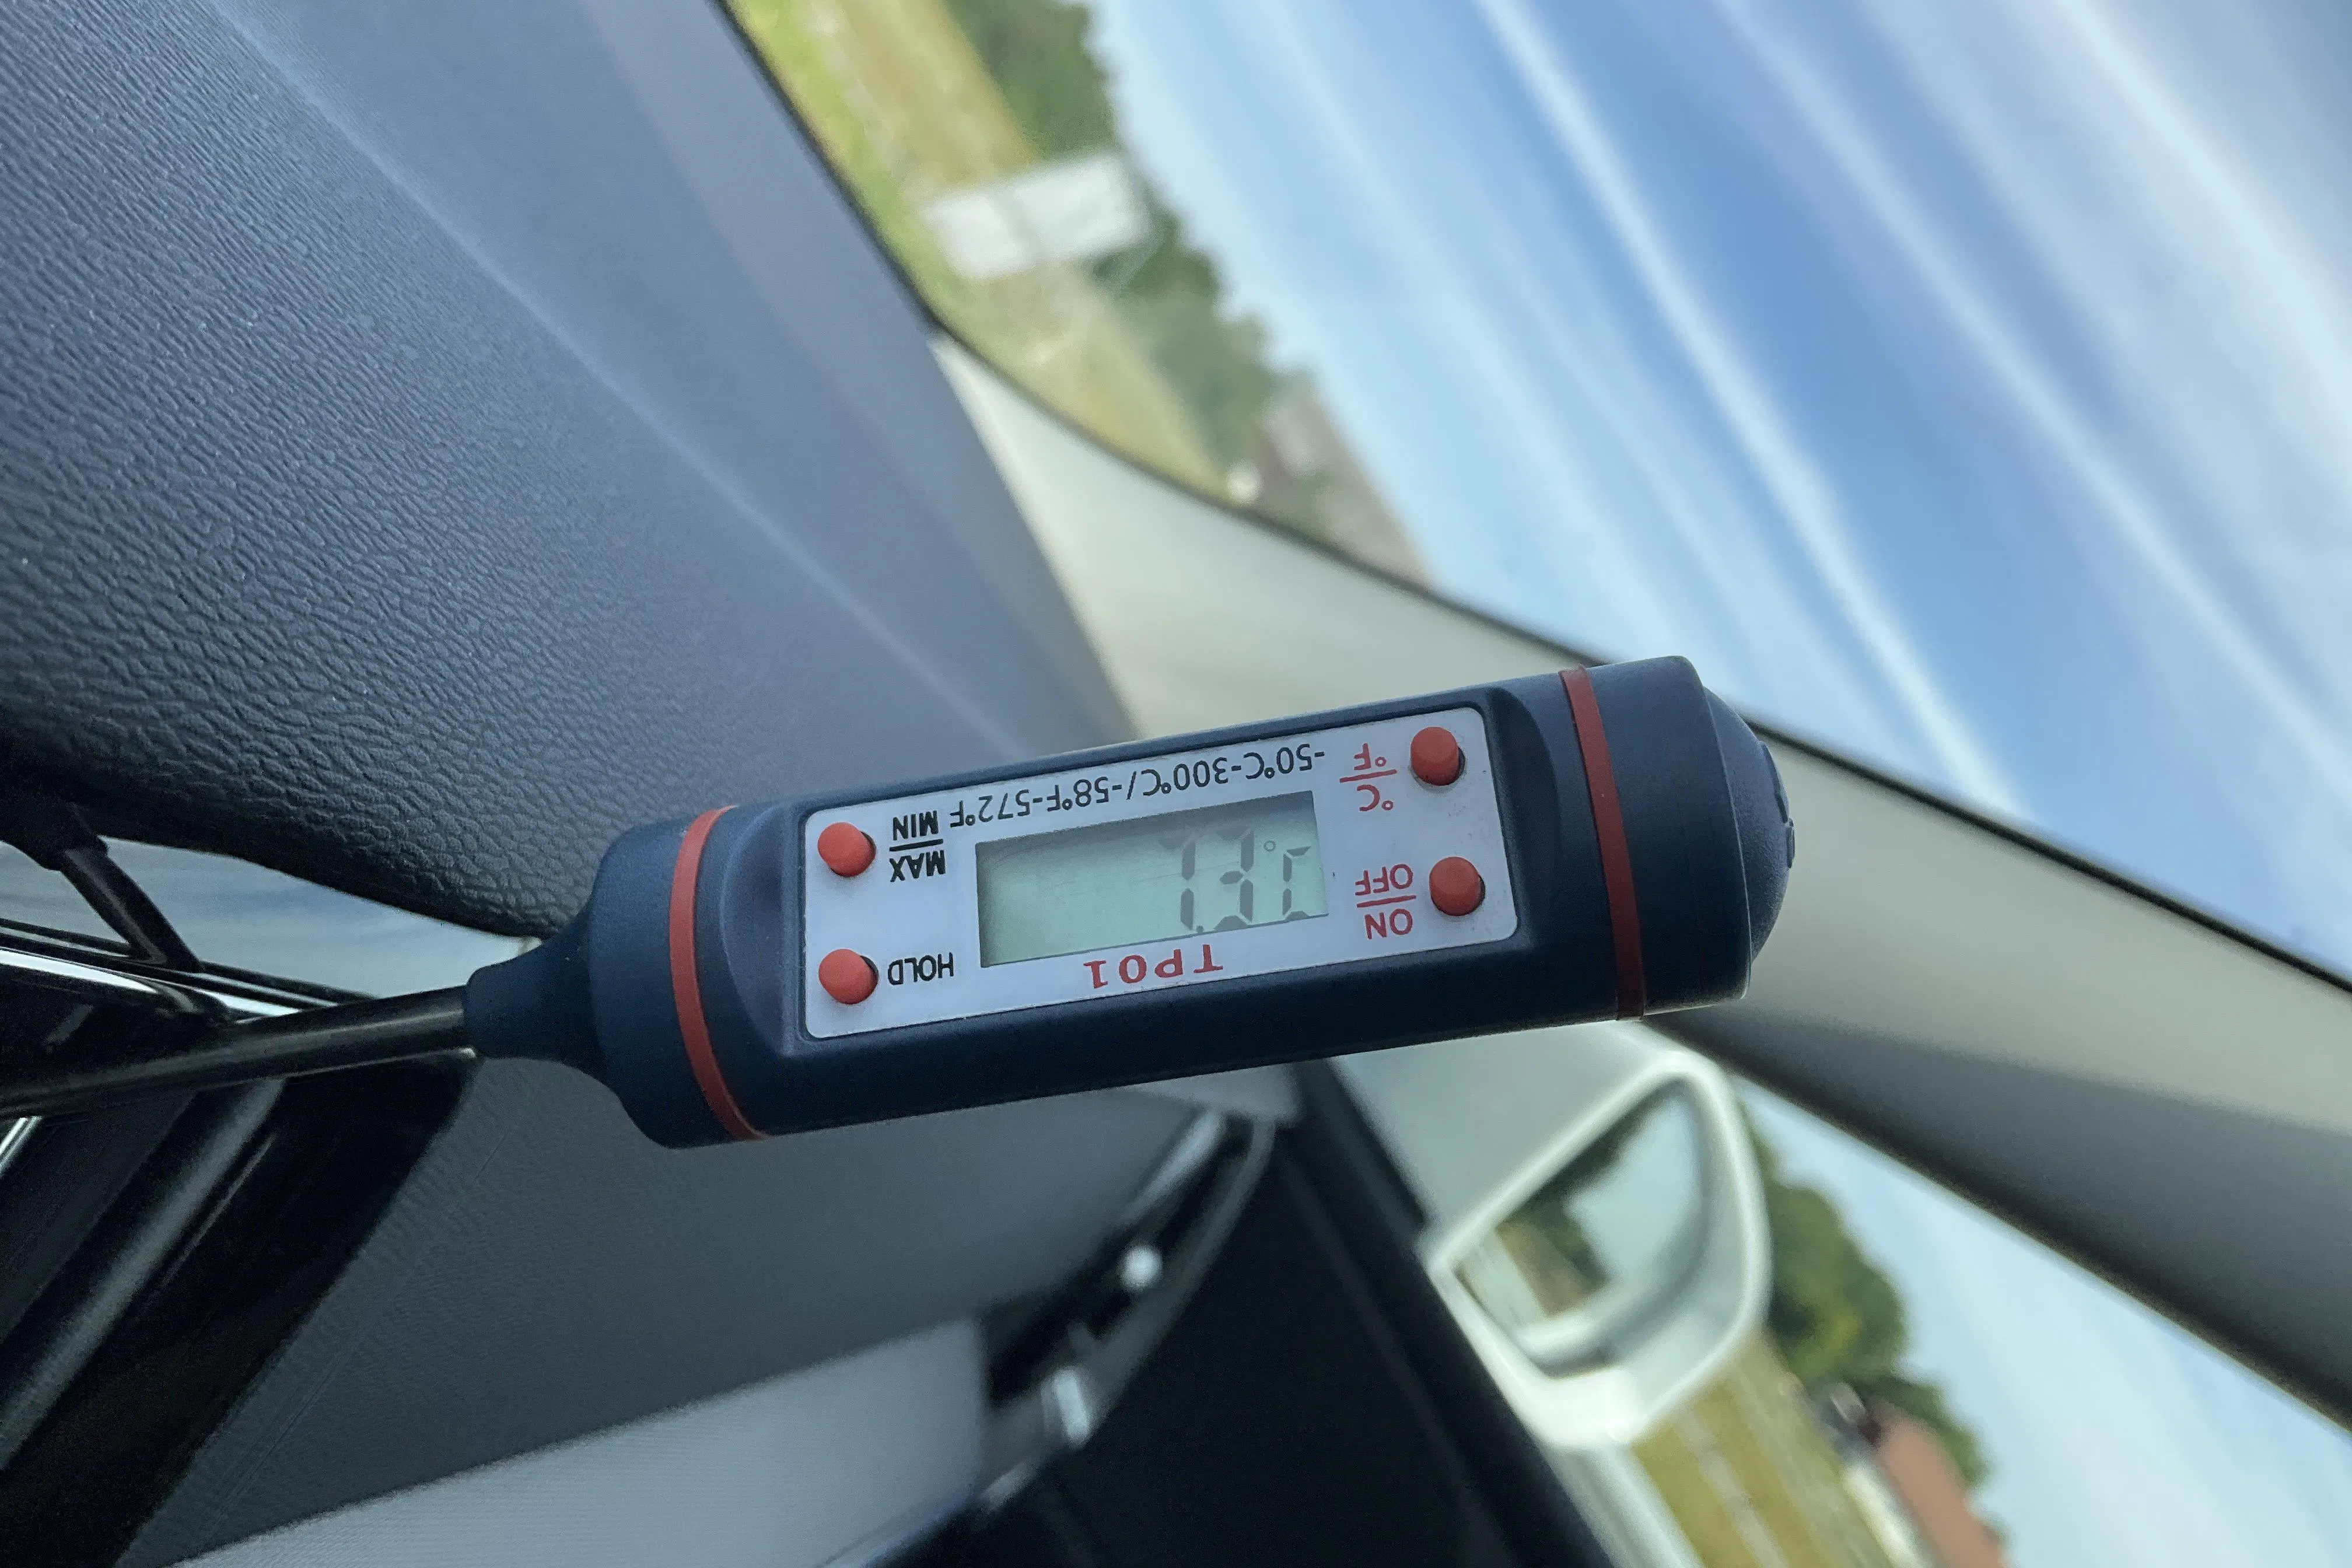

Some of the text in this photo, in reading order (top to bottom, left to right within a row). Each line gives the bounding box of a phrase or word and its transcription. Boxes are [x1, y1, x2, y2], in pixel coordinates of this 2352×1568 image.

[892, 810, 939, 841] MIN
[889, 849, 946, 882] MAX
[1355, 863, 1413, 895] OFF
[1364, 908, 1413, 939] ON
[887, 951, 954, 985] HOLD
